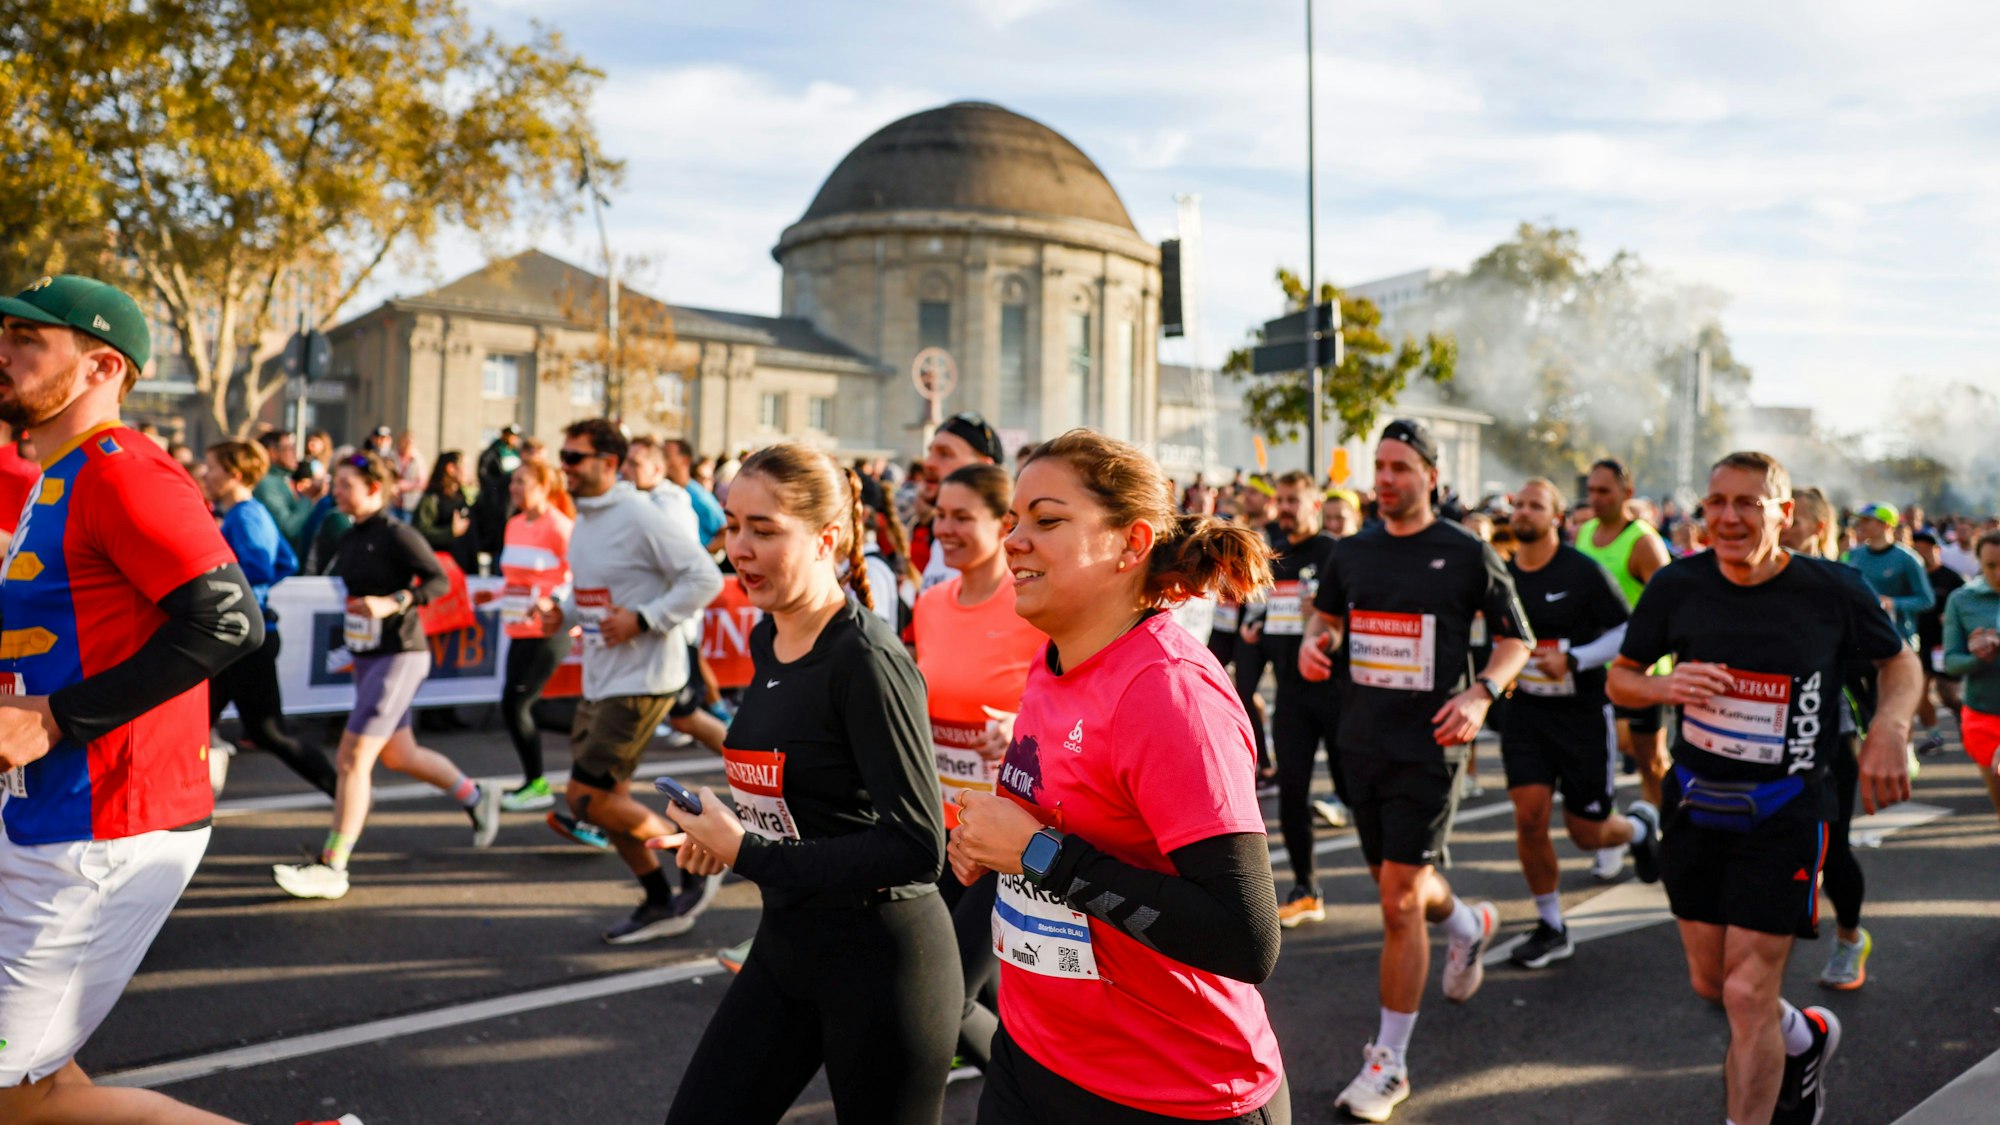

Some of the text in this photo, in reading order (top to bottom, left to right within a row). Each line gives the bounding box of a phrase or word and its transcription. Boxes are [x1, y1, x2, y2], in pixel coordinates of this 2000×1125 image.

[1350, 641, 1411, 657] Christian
[1038, 923, 1083, 937] Startblock BLAU
[1012, 948, 1035, 966] PUMA
